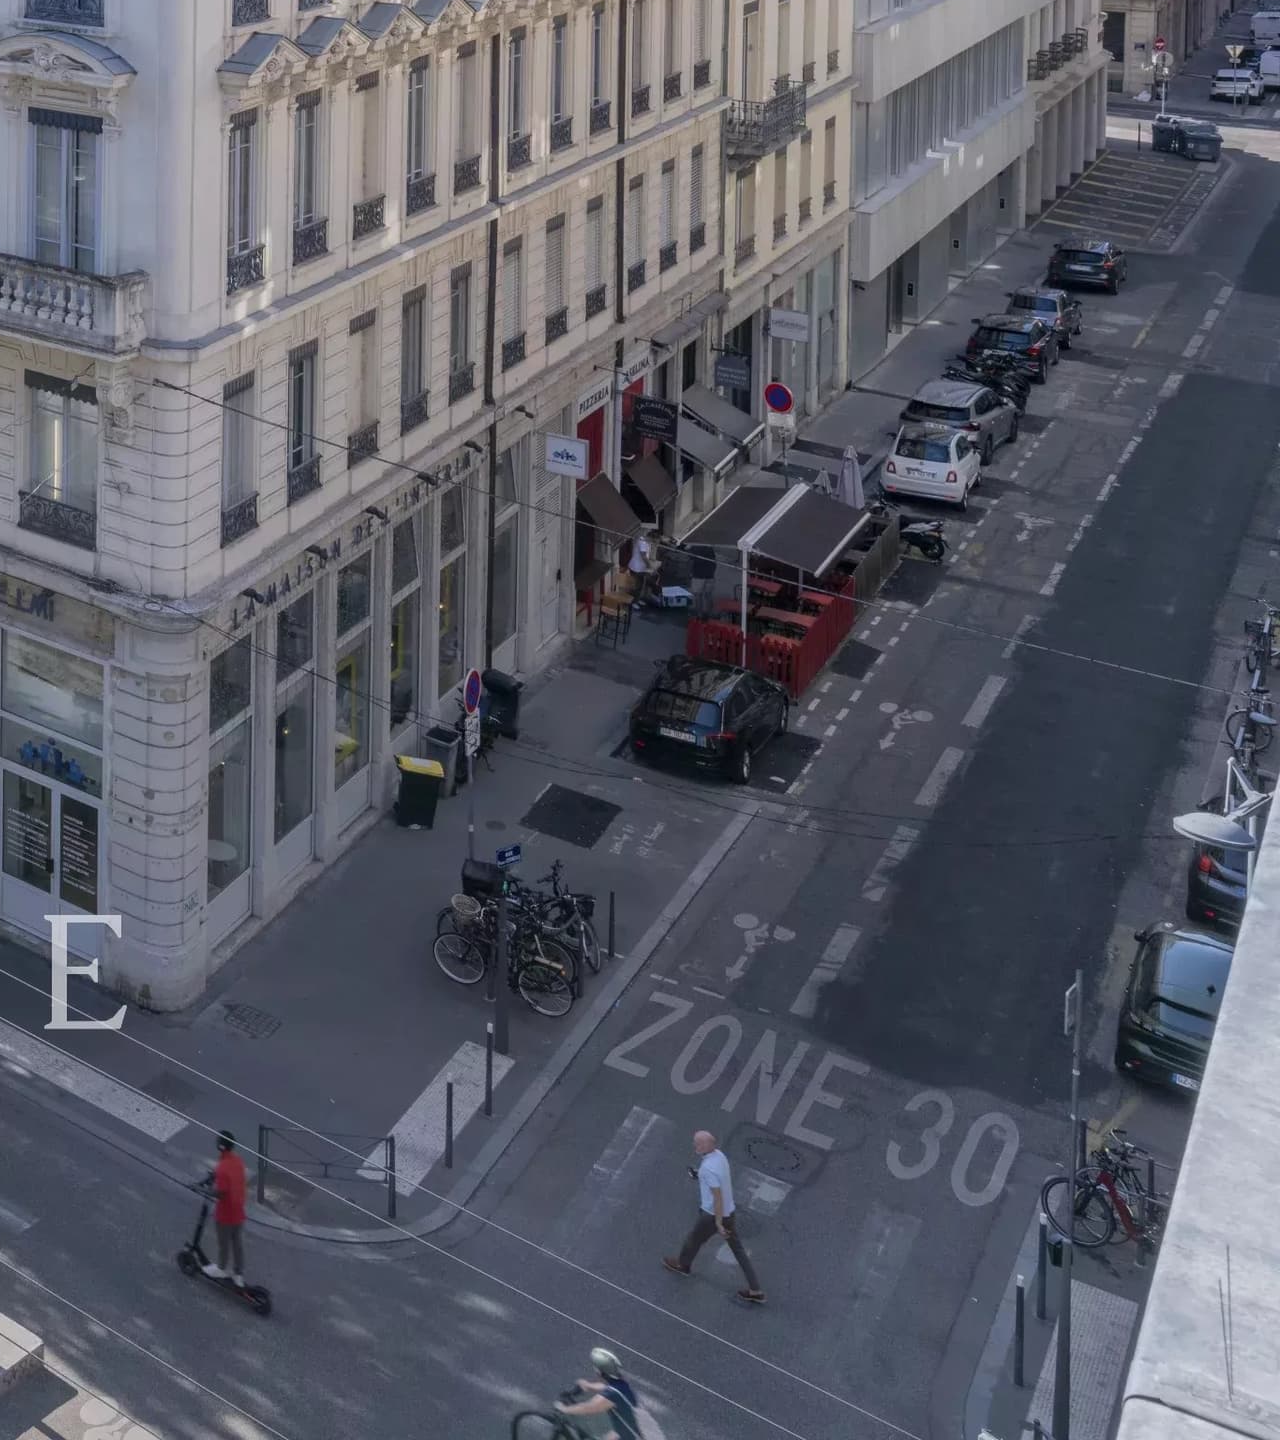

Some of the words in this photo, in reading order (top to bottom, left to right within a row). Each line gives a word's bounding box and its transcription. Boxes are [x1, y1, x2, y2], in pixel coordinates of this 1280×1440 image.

[579, 385, 609, 415] PIZZERIA
[16, 588, 54, 622] LMI
[233, 595, 256, 630] LA
[264, 537, 341, 608] MAISON
[351, 515, 374, 547] DE
[603, 991, 871, 1150] ZONE
[885, 1090, 1019, 1206] 30
